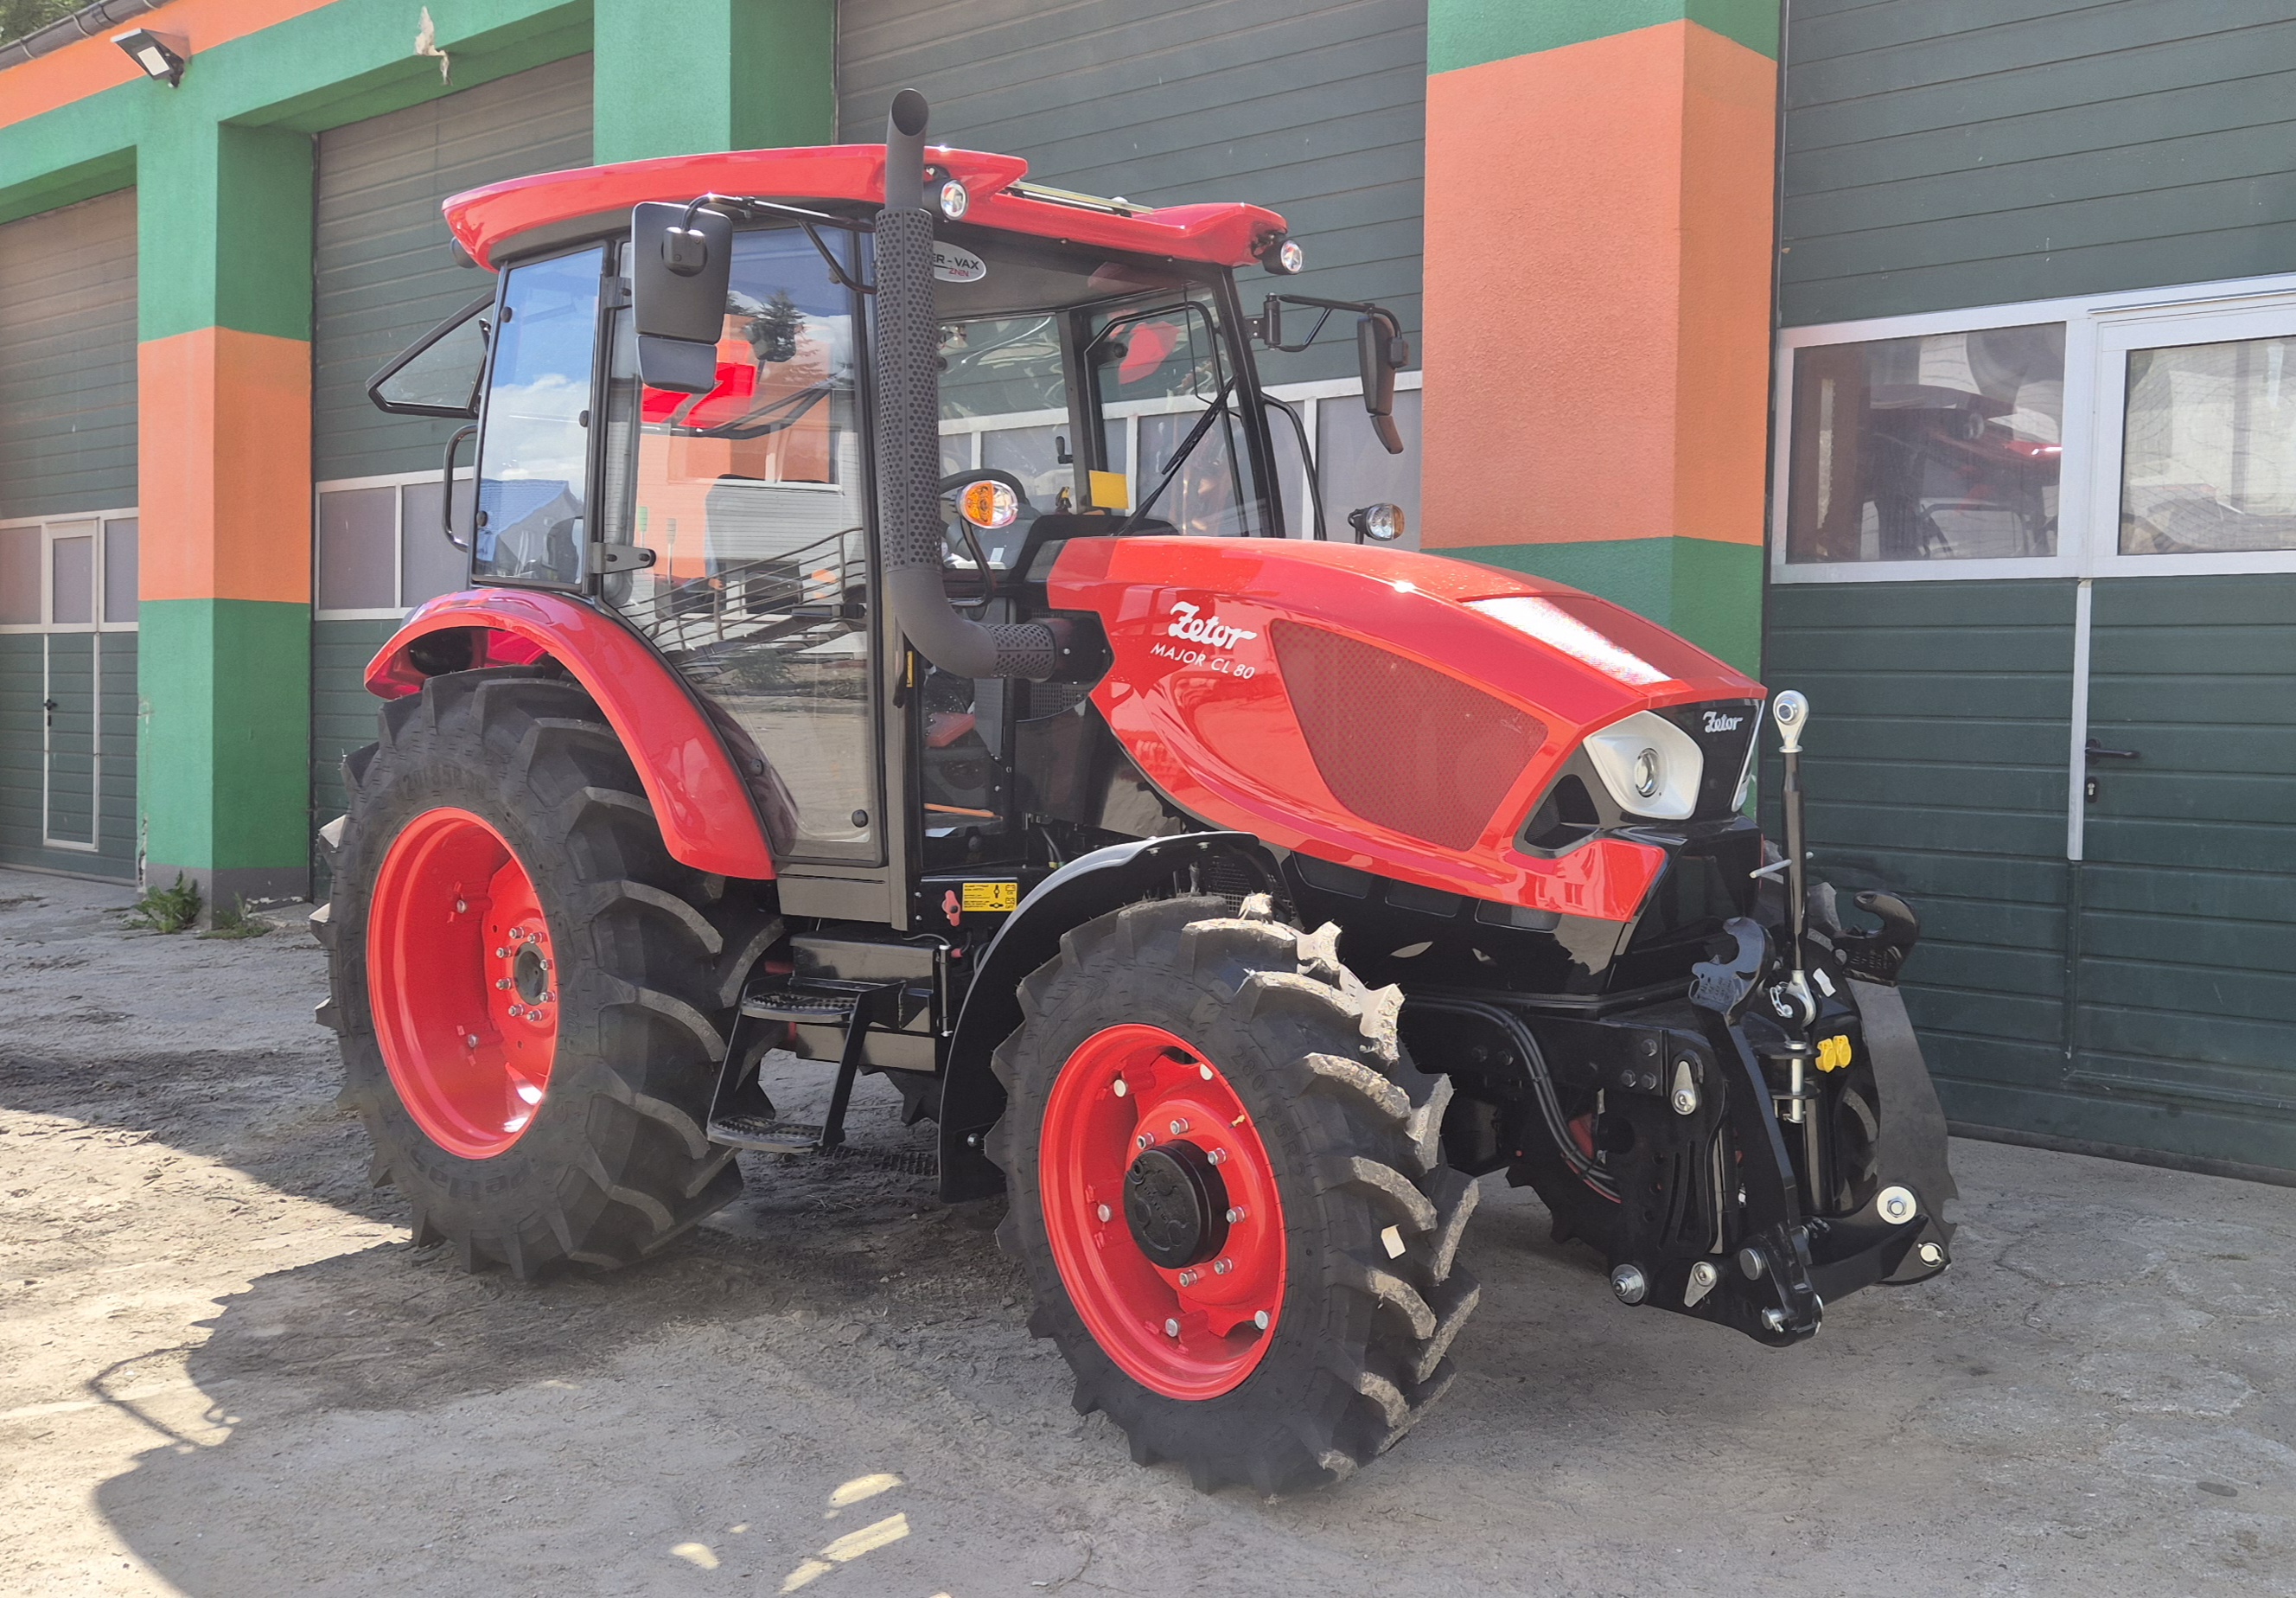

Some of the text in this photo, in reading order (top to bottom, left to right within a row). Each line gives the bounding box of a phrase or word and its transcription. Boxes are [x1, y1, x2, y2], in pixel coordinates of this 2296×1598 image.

[954, 257, 979, 270] VAX
[1168, 601, 1258, 649] Zetor
[1150, 642, 1255, 680] MAJOR CL 80
[1702, 711, 1744, 733] Zetor
